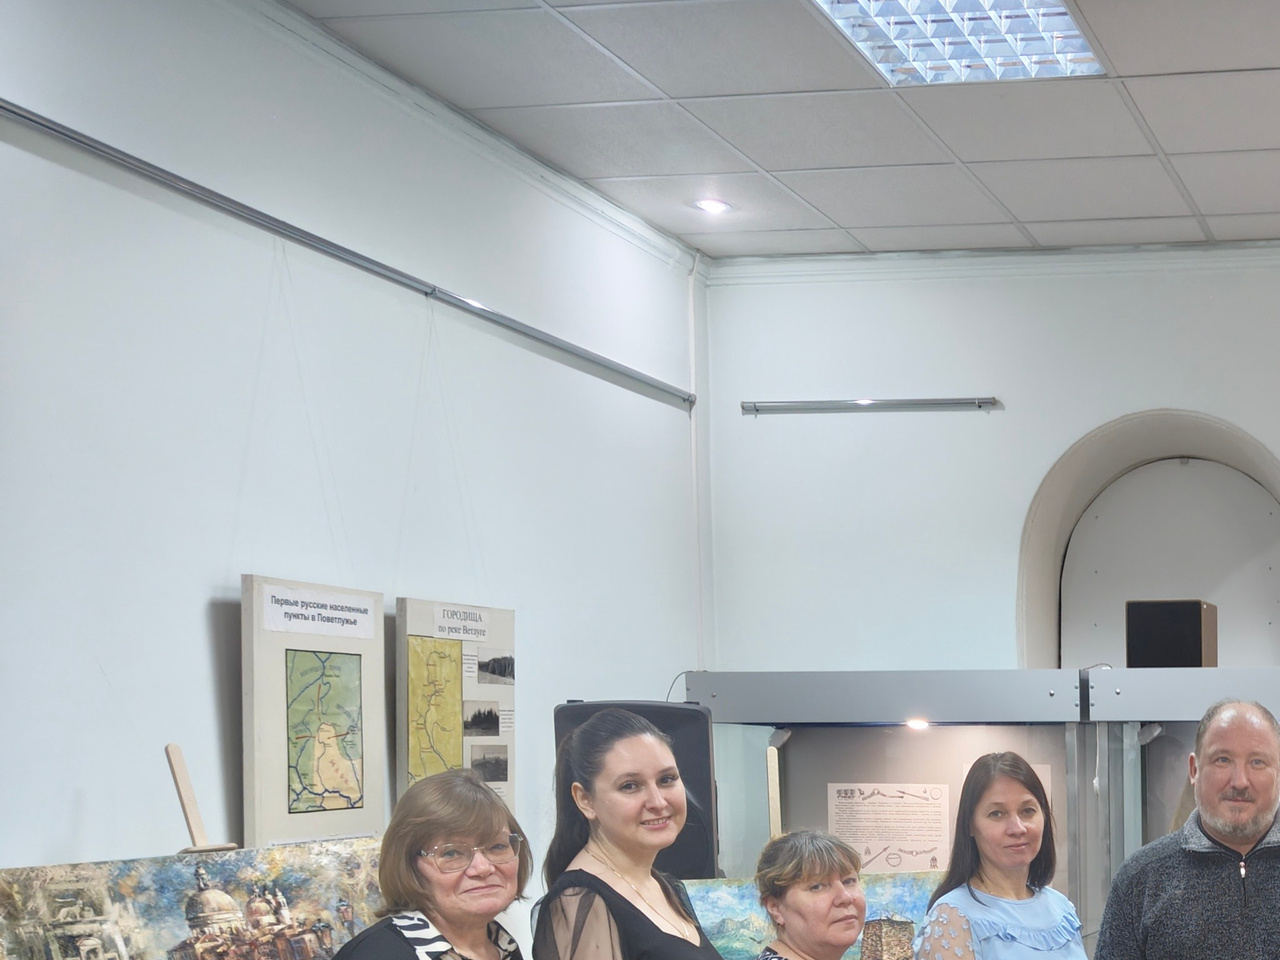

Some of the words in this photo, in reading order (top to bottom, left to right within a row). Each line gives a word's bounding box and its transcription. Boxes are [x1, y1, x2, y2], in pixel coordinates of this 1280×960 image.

[271, 595, 299, 607] Первые
[300, 600, 328, 611] русские
[329, 604, 369, 615] населенные
[284, 611, 310, 621] пункты
[317, 613, 358, 626] Поветлужье
[442, 609, 483, 623] ГОРОДИЩА
[438, 625, 447, 633] по
[447, 626, 462, 636] реке
[462, 625, 487, 638] Ветлуге
